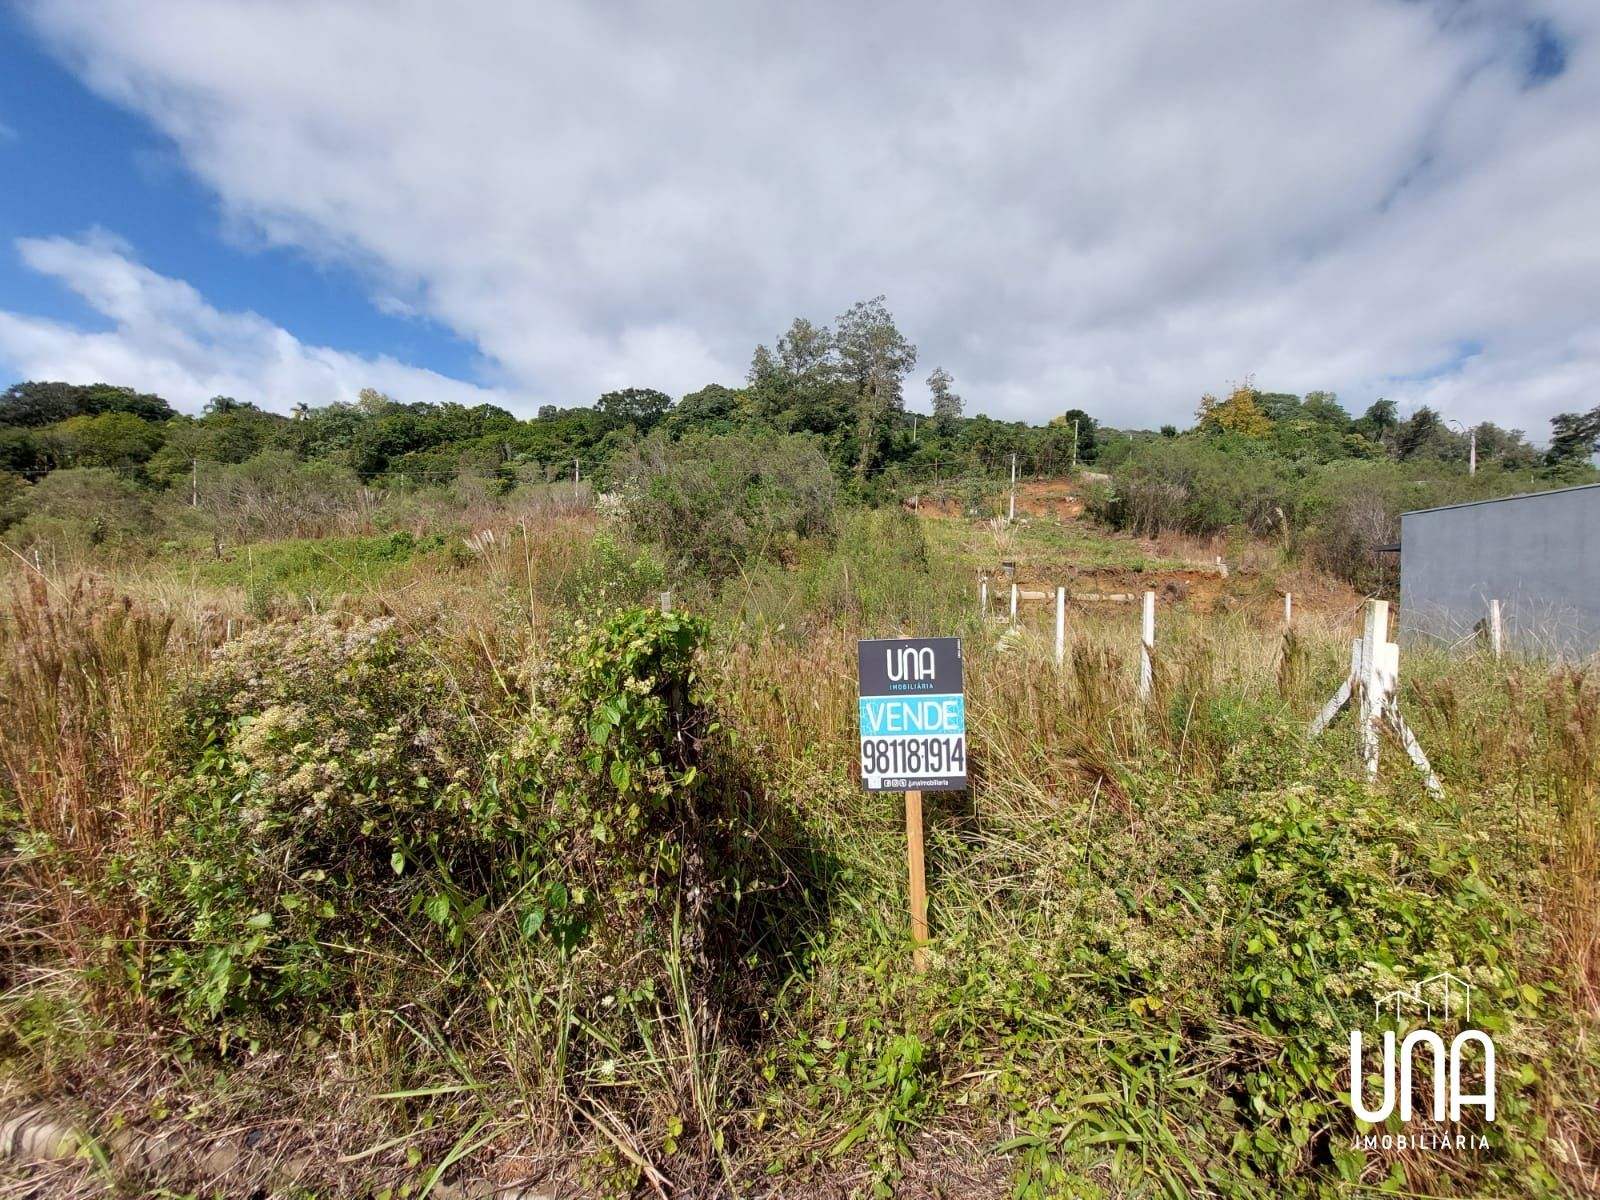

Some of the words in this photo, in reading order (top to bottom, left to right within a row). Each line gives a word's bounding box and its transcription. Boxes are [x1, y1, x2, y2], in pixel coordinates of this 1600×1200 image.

[886, 647, 936, 682] UNA
[889, 682, 934, 690] IMOBILIÁRIA
[866, 702, 958, 732] VENDE
